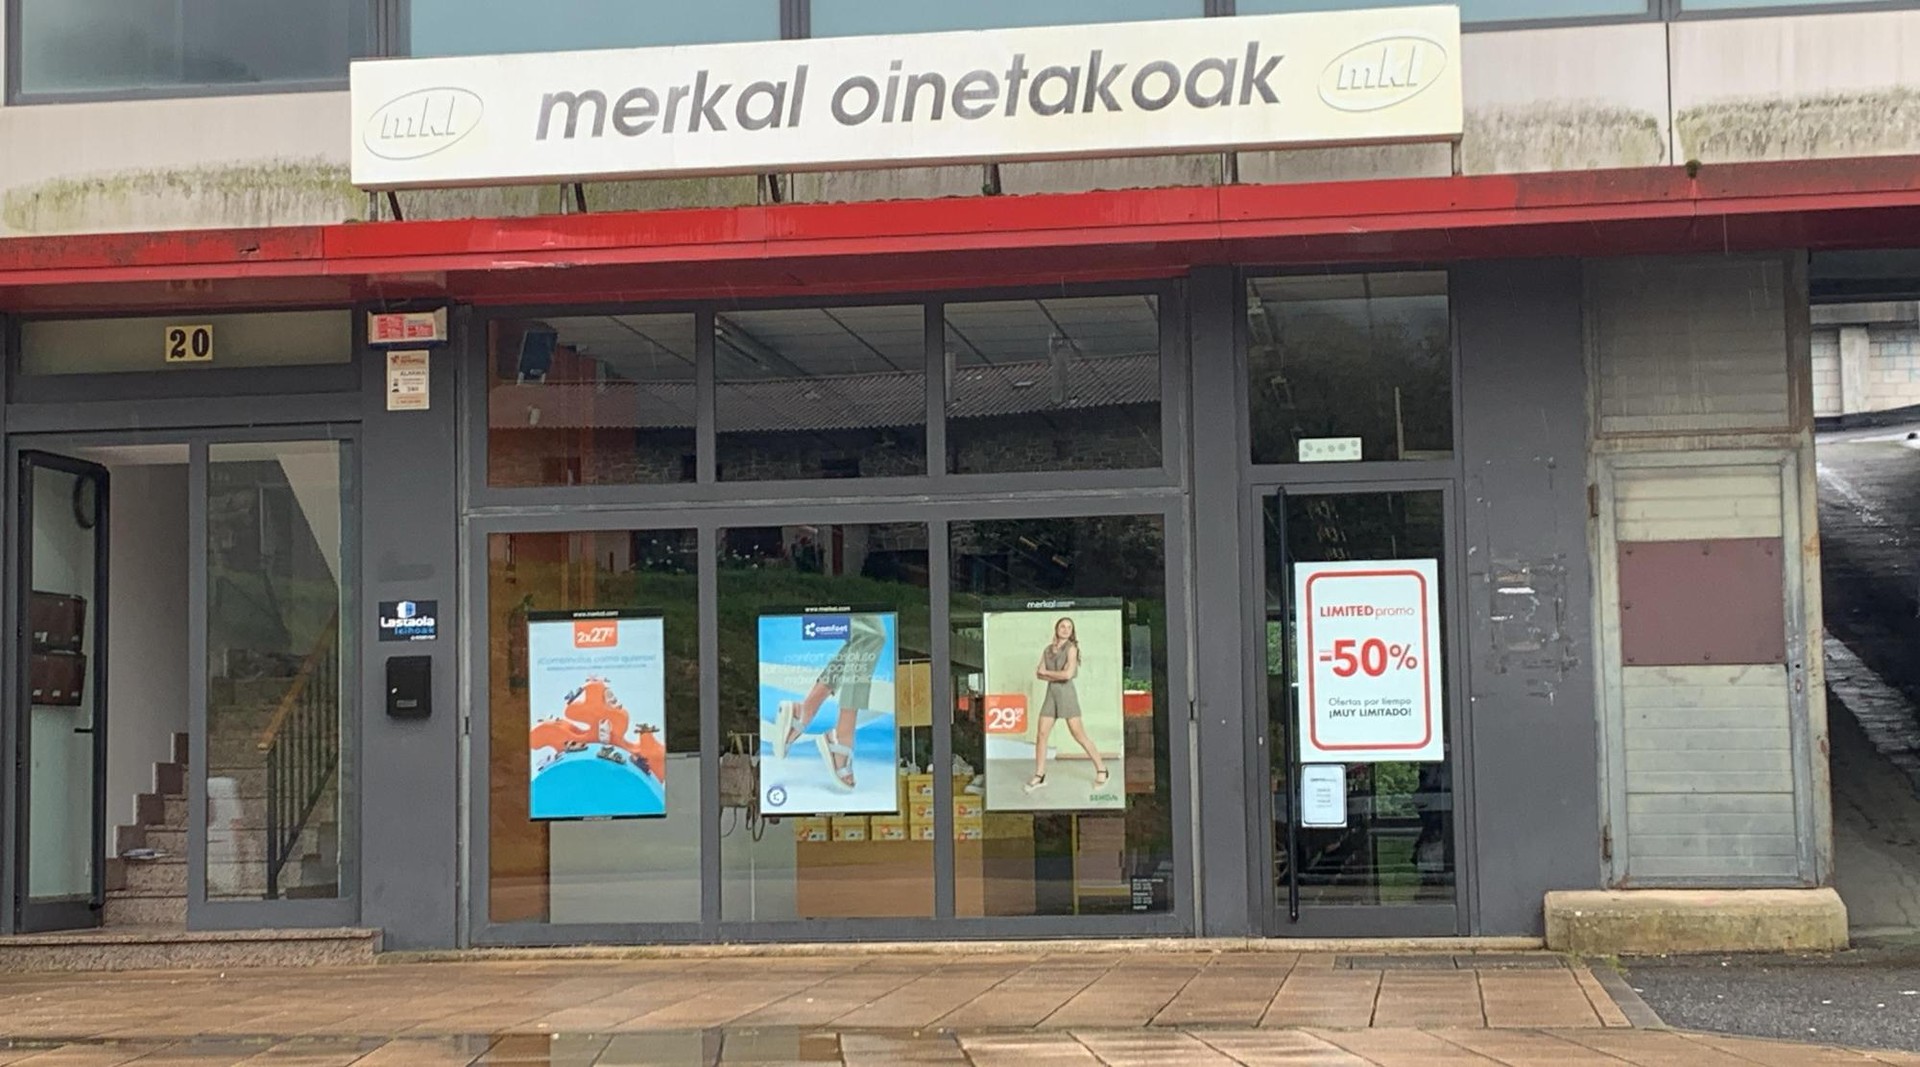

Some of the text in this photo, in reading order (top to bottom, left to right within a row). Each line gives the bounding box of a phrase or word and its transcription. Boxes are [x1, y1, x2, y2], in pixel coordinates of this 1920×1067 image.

[536, 41, 1285, 141] merkal oinetakoak
[169, 328, 210, 358] 20
[1320, 605, 1415, 620] LIMITED promo
[1319, 637, 1418, 678] -50%
[1328, 697, 1412, 708] Ofertas por tiempo
[1359, 707, 1412, 717] LIMITADO!
